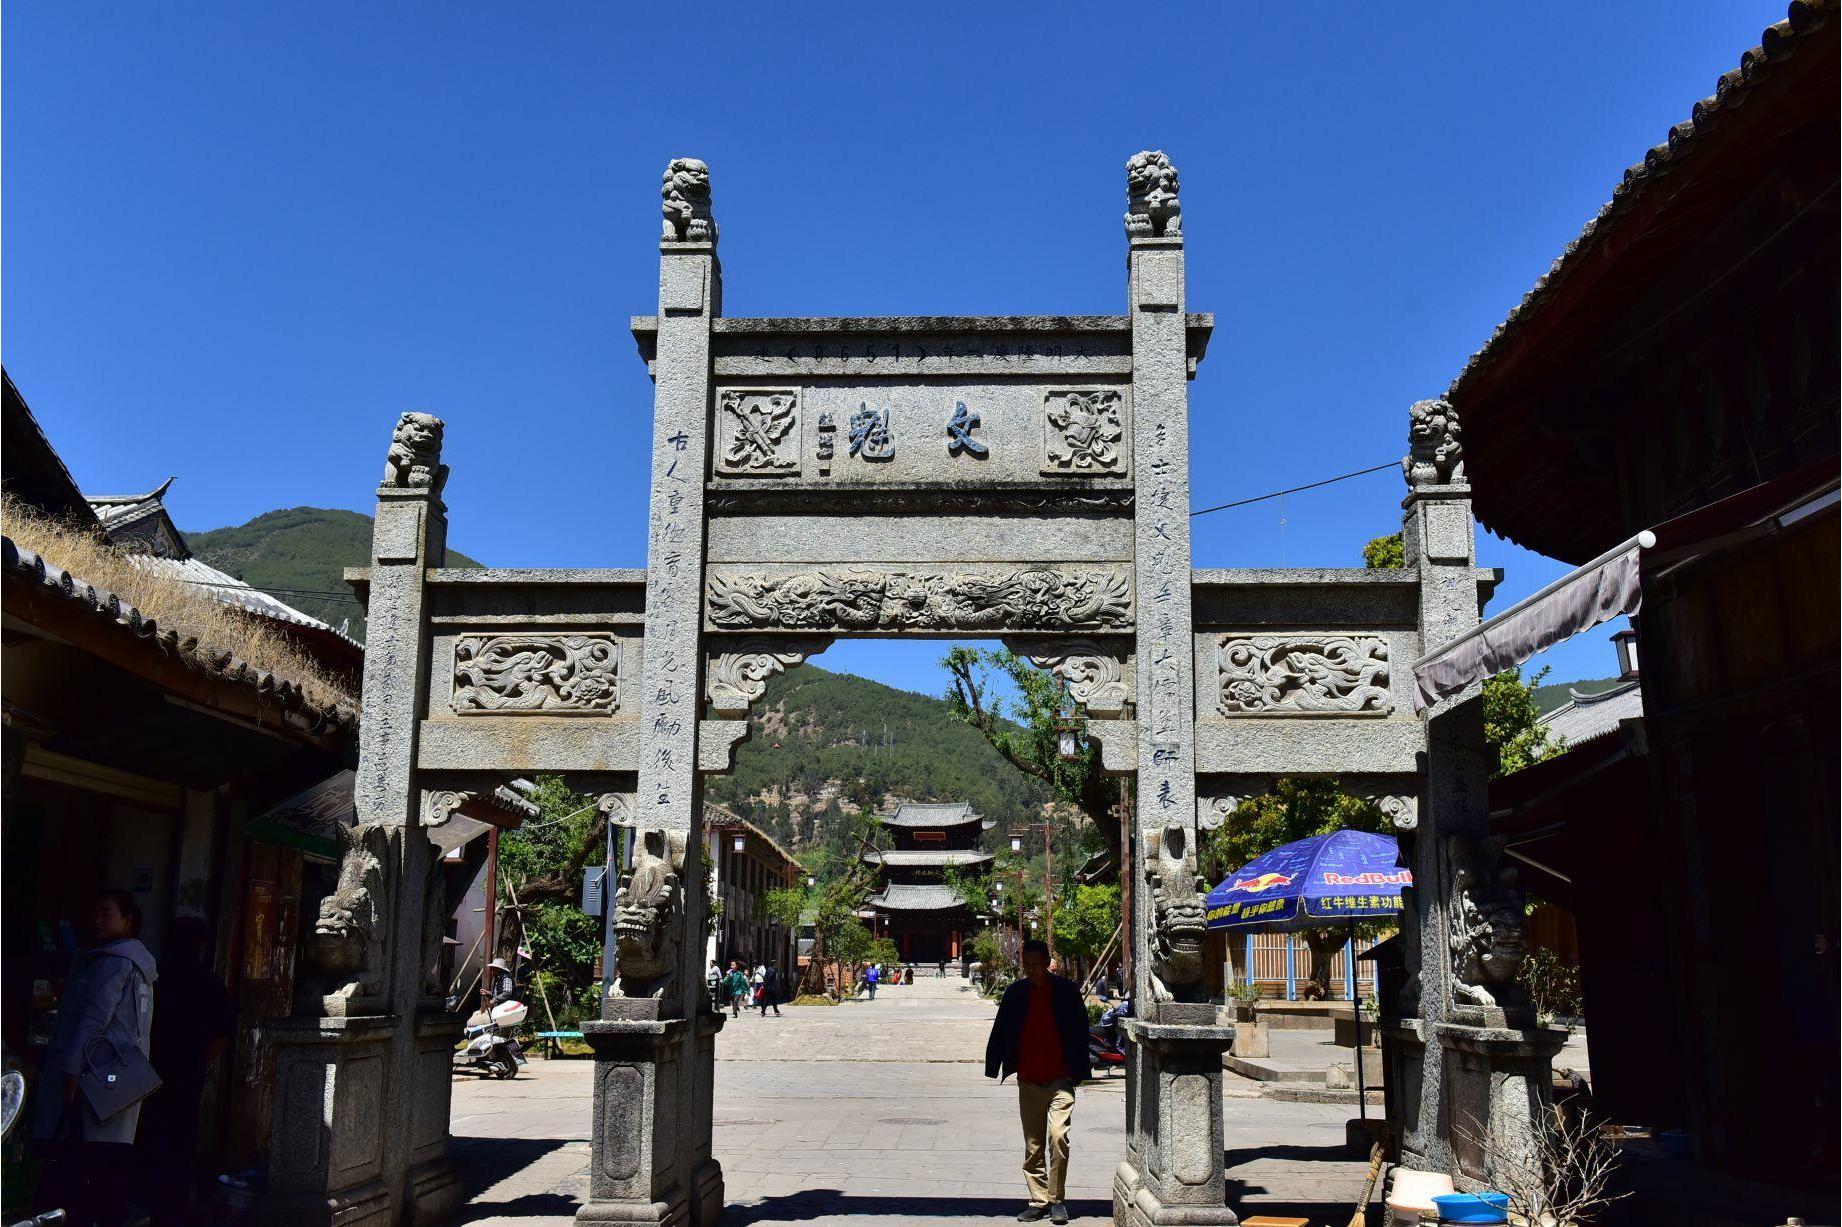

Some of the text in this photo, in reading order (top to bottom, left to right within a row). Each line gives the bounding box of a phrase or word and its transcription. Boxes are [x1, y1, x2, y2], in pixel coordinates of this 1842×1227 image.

[847, 400, 990, 463] 文魁
[1321, 895, 1405, 910] 红牛维生素功能
